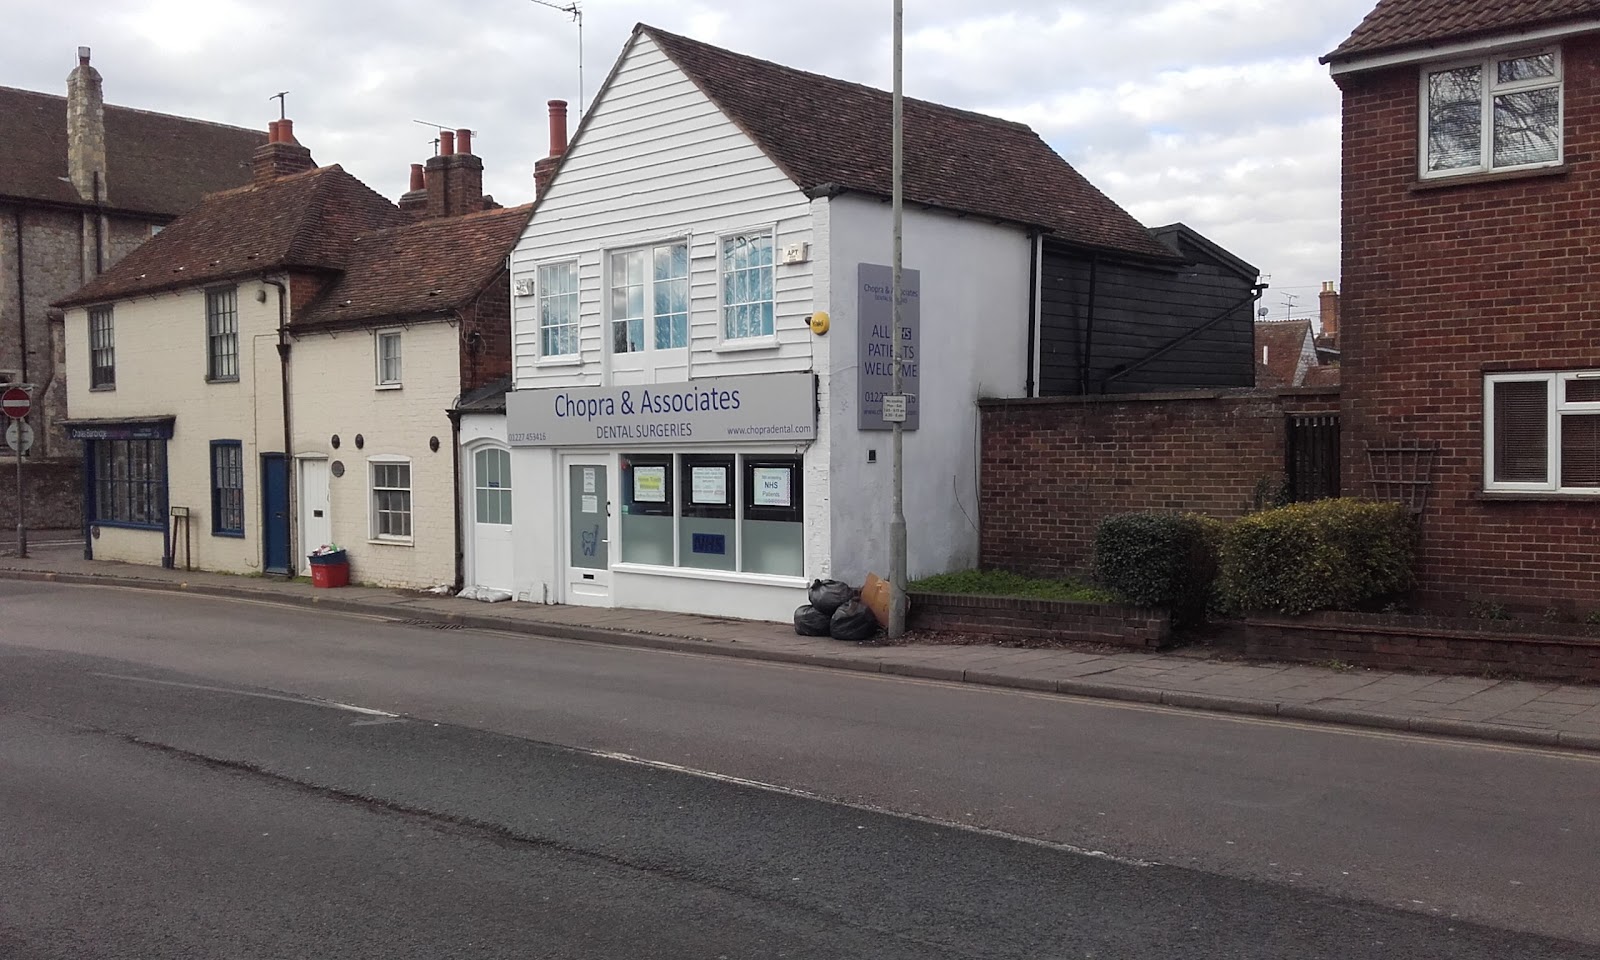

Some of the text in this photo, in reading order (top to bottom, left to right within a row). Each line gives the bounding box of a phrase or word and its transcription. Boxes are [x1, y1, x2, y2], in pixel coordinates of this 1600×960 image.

[863, 283, 884, 295] Chopra
[872, 324, 890, 339] ALL
[868, 342, 915, 359] PATIETS
[864, 361, 918, 377] WELCME
[554, 386, 741, 422] Chopra & Associates
[508, 432, 547, 442] 01227 453416
[596, 422, 693, 439] DENTAL SURGERIES
[727, 424, 811, 435] www.chopradental.com
[764, 481, 778, 489] NHS
